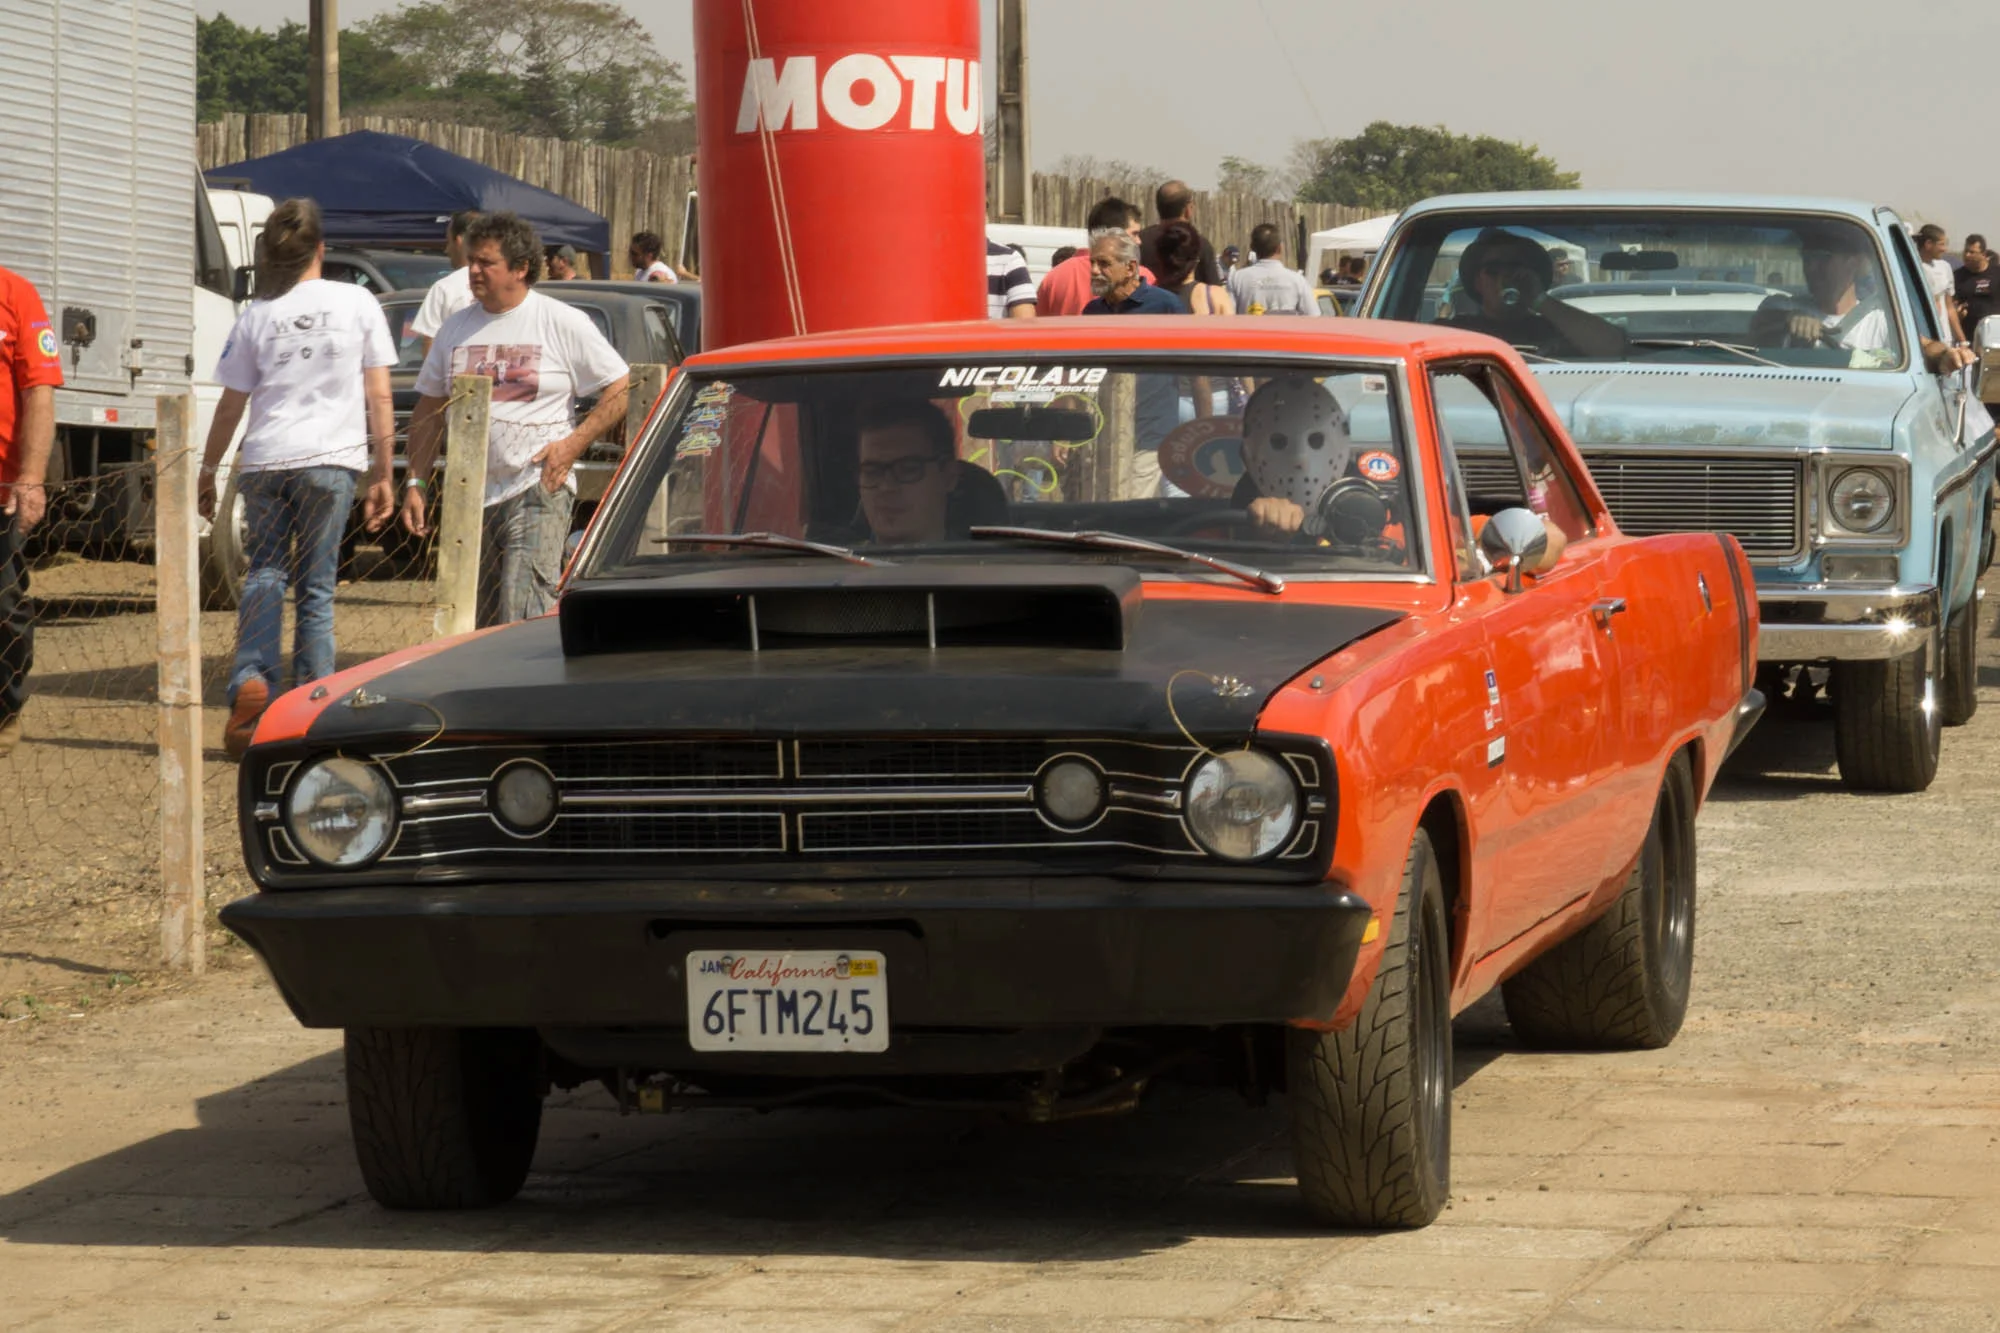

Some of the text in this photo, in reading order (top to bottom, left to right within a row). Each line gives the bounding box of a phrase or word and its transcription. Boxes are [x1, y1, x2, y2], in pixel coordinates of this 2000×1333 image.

[735, 53, 984, 135] MOTU
[699, 960, 723, 974] JAN
[730, 957, 837, 987] California
[703, 989, 873, 1035] 6FTM245
